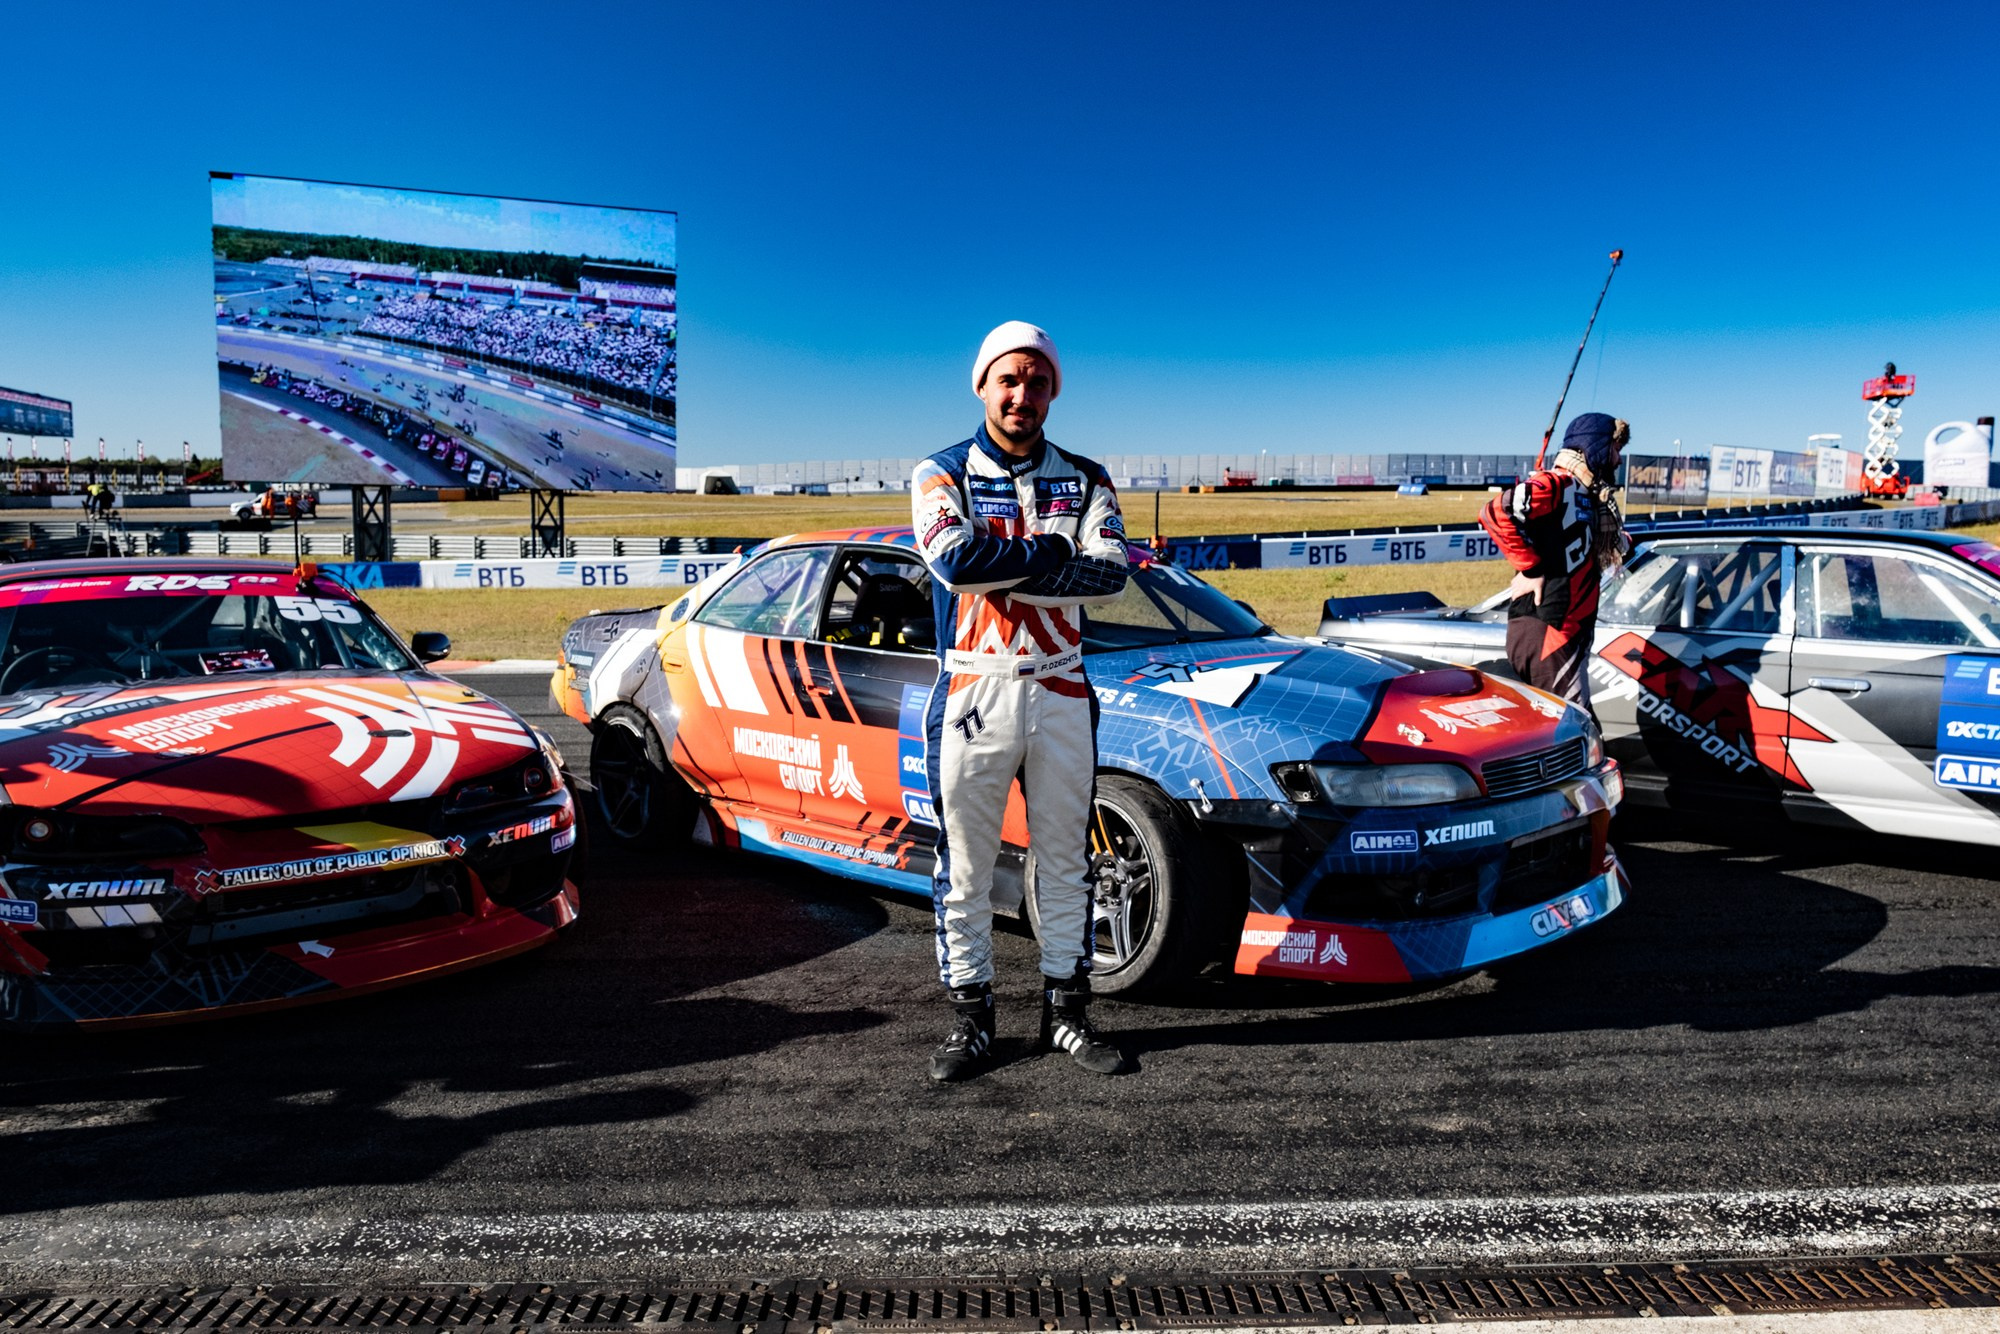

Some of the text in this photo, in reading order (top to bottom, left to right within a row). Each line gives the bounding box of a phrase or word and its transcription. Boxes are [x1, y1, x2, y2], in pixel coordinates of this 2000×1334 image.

[1735, 460, 1762, 488] ВТБ
[1050, 482, 1079, 494] ВТБ
[974, 504, 1016, 514] AIMOL
[1309, 545, 1347, 565] ВТБ
[1390, 541, 1426, 561] ВТБ
[124, 575, 236, 591] RDS
[478, 567, 525, 587] ВТБ
[581, 565, 628, 586] ВТБ
[274, 596, 362, 624] 55
[1118, 693, 1138, 708] F.
[108, 693, 300, 740] МОСКОВСКИЙ
[952, 705, 985, 743] 77
[133, 718, 233, 751] СПОРТ
[734, 726, 821, 768] МОСКОВСКИЙ
[779, 763, 825, 796] СПОРТ
[1354, 835, 1416, 849] AIMOL
[1424, 820, 1496, 846] XENUM
[782, 831, 898, 866] FALLEN OUT OF PUBLIC OPINION
[223, 841, 446, 887] FALLEN OUT OF PUBLIC OPINION
[43, 878, 166, 900] XENUM
[1241, 929, 1316, 948] МОСКОВСКИЙ
[1280, 947, 1315, 964] СПОРТ
